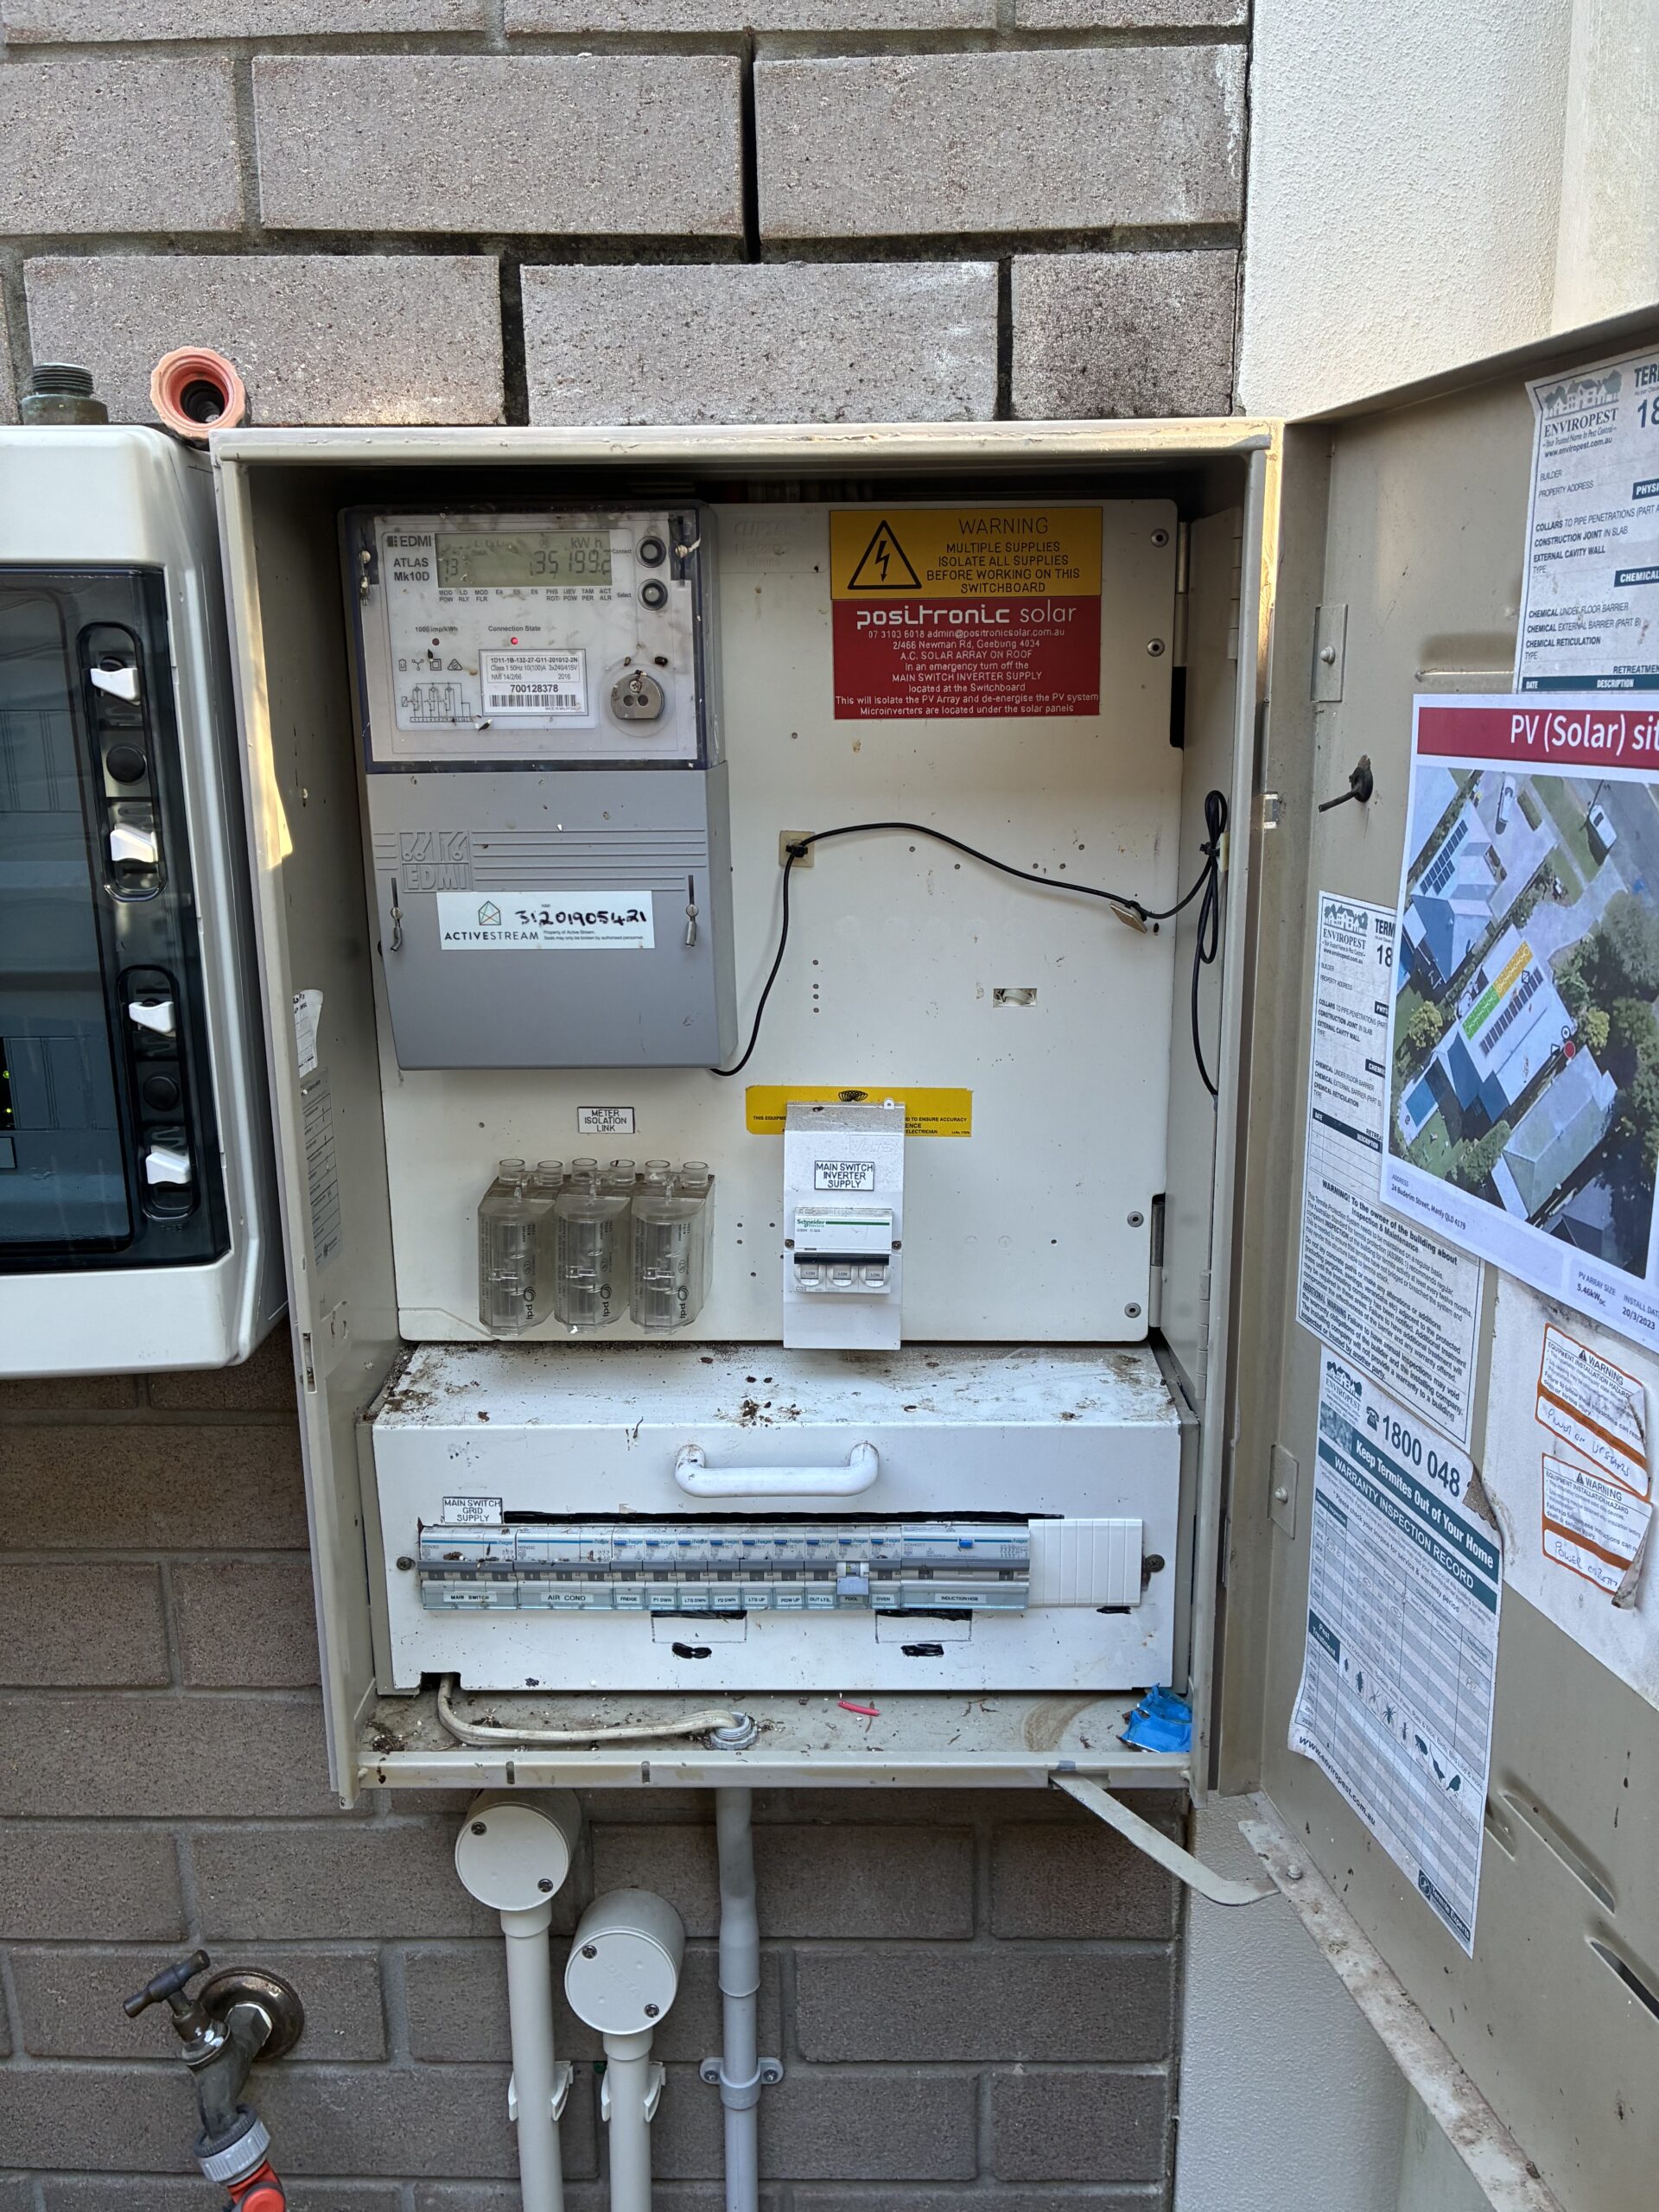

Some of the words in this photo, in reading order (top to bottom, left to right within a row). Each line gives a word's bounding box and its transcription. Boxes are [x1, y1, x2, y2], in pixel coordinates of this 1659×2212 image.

[1543, 408, 1619, 438] ENVIROPEST
[1544, 437, 1613, 458] www.enviropest.com.au
[1540, 470, 1562, 482] BUILDER
[1538, 486, 1566, 499] PROPERTY
[1567, 480, 1594, 493] ADDRESS
[958, 518, 1048, 534] WARNING
[1535, 518, 1563, 532] COLLARS
[1565, 518, 1573, 528] TO
[1573, 516, 1587, 526] PIPE
[1588, 507, 1637, 524] PENETRATIONS
[400, 536, 432, 547] EDMI
[1534, 533, 1581, 547] CONSTRUCTION
[1583, 530, 1603, 541] JOINT
[1604, 529, 1611, 537] IN
[1611, 525, 1628, 536] SLAB
[947, 543, 1001, 553] MULTIPLE
[1005, 542, 1060, 553] SUPPLIES
[1534, 551, 1564, 563] EXTERNAL
[1565, 548, 1586, 559] CAVITY
[1587, 545, 1605, 555] WALL
[393, 558, 429, 568] ATLAS
[938, 556, 986, 567] ISOLATE
[989, 556, 1010, 566] ALL
[1014, 555, 1069, 566] SUPPLIES
[394, 572, 429, 582] Mk10D
[927, 570, 973, 581] BEFORE
[977, 569, 1032, 580] WORKING
[1035, 569, 1051, 579] ON
[1055, 569, 1080, 579] THIS
[961, 582, 1046, 594] SWITCHBOARD
[856, 604, 1010, 630] positronic
[1020, 599, 1077, 623] solar
[904, 630, 925, 639] 6018
[927, 629, 1065, 639] admin@positronicsolar.com.au
[1526, 639, 1555, 648] CHEMICAL
[1556, 636, 1601, 646] RETICULATION
[893, 641, 916, 650] 2/466
[959, 640, 974, 649] Rd,
[977, 639, 1017, 649] Geebung
[1020, 639, 1040, 648] 4034
[900, 652, 918, 660] A.C.
[921, 651, 953, 660] SOLAR
[956, 651, 987, 659] ARRAY
[1006, 650, 1033, 658] ROOF
[905, 663, 913, 671] In
[929, 663, 977, 672] emergency
[893, 674, 916, 683] MAIN
[918, 673, 954, 682] SWITCH
[957, 672, 1003, 681] INVERTER
[1006, 671, 1042, 680] SUPPLY
[909, 684, 940, 693] located
[970, 683, 1026, 692] Switchboard
[1510, 714, 1540, 745] PV
[1544, 712, 1626, 756] (Solar)
[406, 865, 467, 891] EDMI
[444, 931, 539, 941] ACTIVESTREAM
[1323, 928, 1366, 950] ENVIROPEST
[816, 1163, 838, 1172] MAIN
[840, 1163, 874, 1172] SWITCH
[823, 1171, 866, 1180] INVERTER
[827, 1180, 861, 1189] SUPPLY
[1322, 1179, 1351, 1202] WARNING!
[1351, 1197, 1358, 1207] To
[1360, 1202, 1370, 1213] the
[1370, 1209, 1389, 1225] owner
[1390, 1221, 1397, 1230] of
[1398, 1224, 1408, 1236] the
[1410, 1230, 1436, 1254] building
[1438, 1248, 1458, 1266] about
[1352, 1207, 1378, 1229] Inspection
[1384, 1227, 1419, 1253] Maintenance
[1445, 1213, 1454, 1224] QLD
[1454, 1218, 1466, 1230] 4179
[1579, 1271, 1586, 1280] PV
[1586, 1275, 1603, 1288] ARRAY
[1604, 1284, 1616, 1295] SIZE
[1624, 1294, 1646, 1312] INSTALL
[1622, 1307, 1656, 1330] 20/3/2023
[1588, 1356, 1624, 1386] WARNING
[1382, 1414, 1422, 1465] 1800
[1427, 1450, 1460, 1497] 048
[1586, 1478, 1623, 1502] WARNING
[1356, 1440, 1376, 1467] Keep
[1377, 1459, 1413, 1499] Termites
[1414, 1490, 1430, 1515] Out
[1432, 1509, 1442, 1523] of
[1443, 1511, 1465, 1543] Your
[1465, 1533, 1494, 1569] Home
[1334, 1456, 1378, 1501] WARRANTY
[1379, 1496, 1432, 1552] INSPECTION
[1433, 1544, 1474, 1589] RECORD
[1319, 1623, 1330, 1640] Pest
[1313, 1626, 1336, 1657] Treatment
[1300, 1735, 1376, 1826] www.enviropest.com.au
